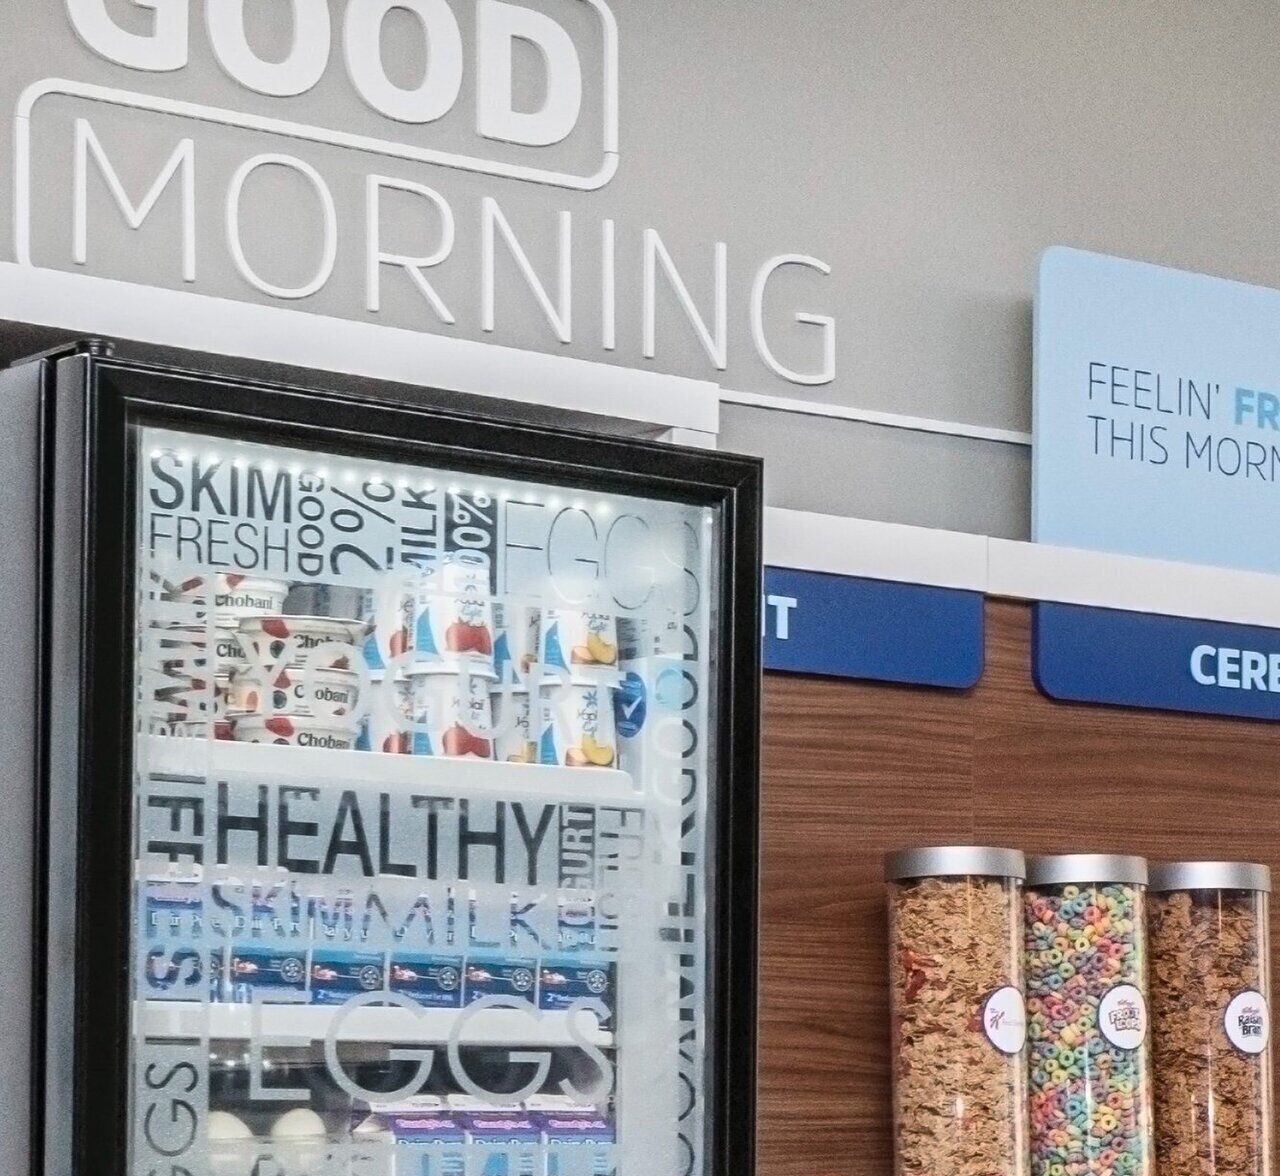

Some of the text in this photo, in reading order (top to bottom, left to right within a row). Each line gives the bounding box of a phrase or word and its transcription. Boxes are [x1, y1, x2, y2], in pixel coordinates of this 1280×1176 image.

[73, 118, 837, 386] MORNING
[1088, 361, 1221, 421] FEELIN'
[1087, 414, 1169, 465] THIS
[149, 450, 293, 524] SKIM
[150, 512, 289, 573] FRESH
[762, 593, 798, 640] T
[294, 685, 350, 704] Cobani
[216, 781, 557, 888] HEALTHY
